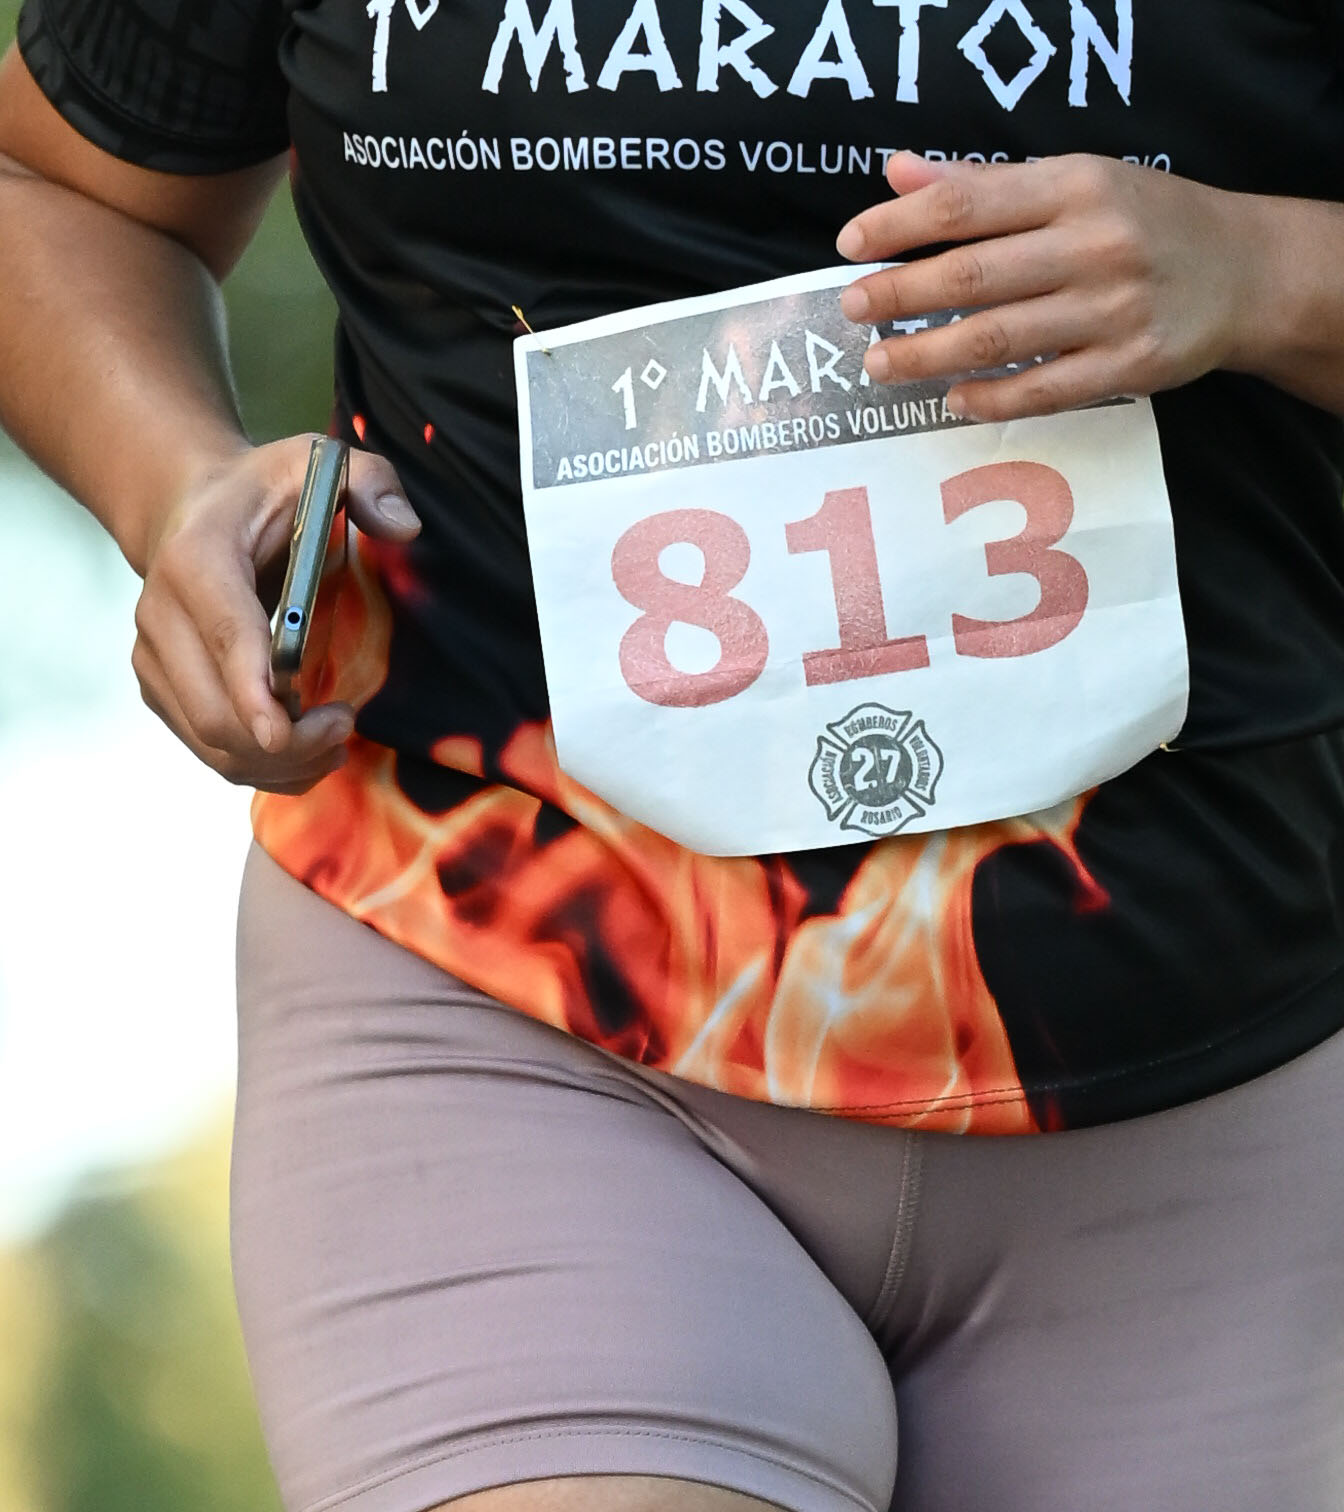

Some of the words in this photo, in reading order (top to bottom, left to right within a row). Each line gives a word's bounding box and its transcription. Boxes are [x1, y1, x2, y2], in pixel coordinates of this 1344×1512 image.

[343, 130, 502, 170] ASOCIACIÓN
[510, 136, 726, 171] BOMBEROS
[556, 432, 699, 481] ASOCIACIÓN
[706, 412, 841, 457] BOMBEROS
[610, 459, 1090, 709] 813
[843, 715, 898, 738] BOMBEROS
[851, 747, 901, 791] 27
[860, 806, 903, 826] ROSARIO
